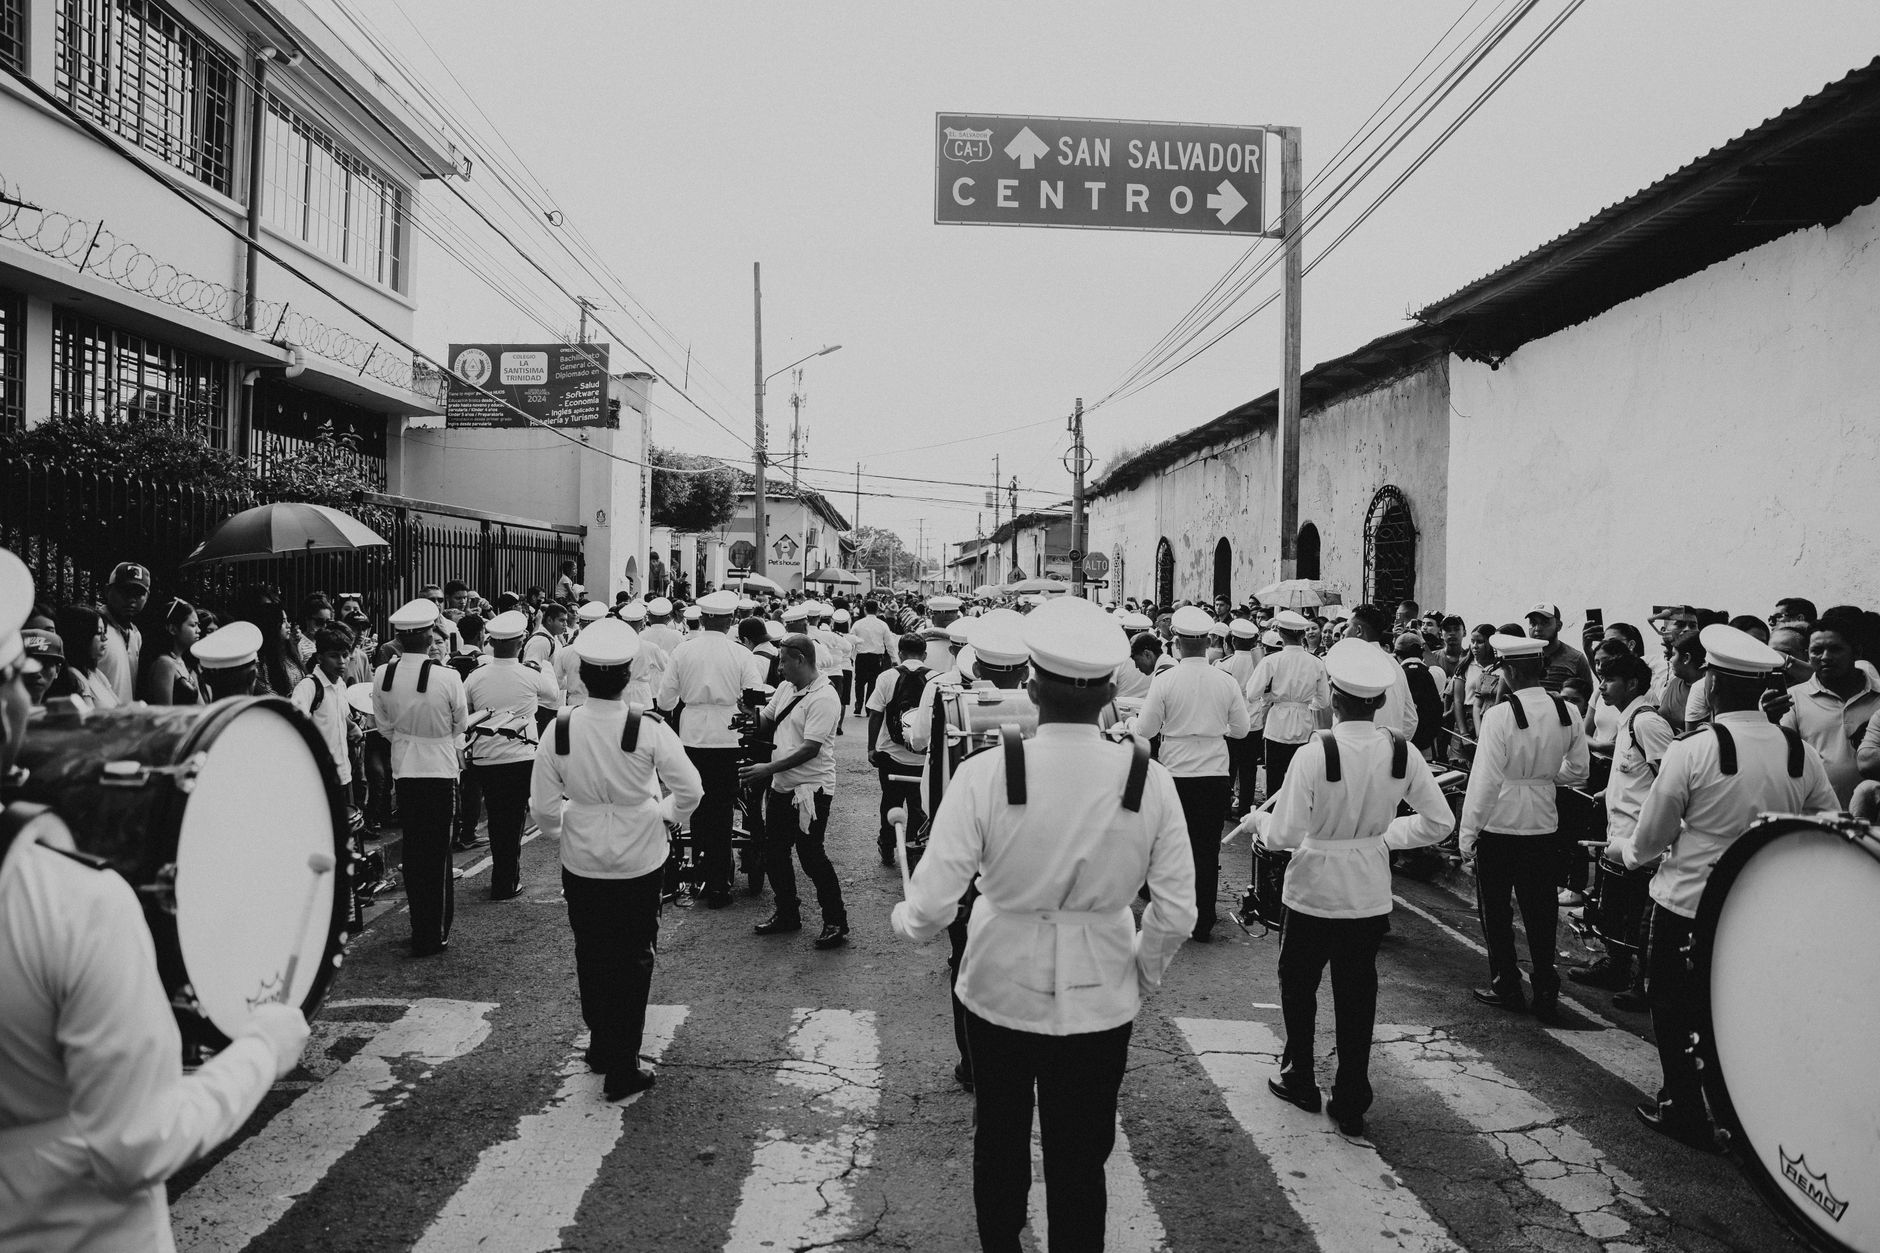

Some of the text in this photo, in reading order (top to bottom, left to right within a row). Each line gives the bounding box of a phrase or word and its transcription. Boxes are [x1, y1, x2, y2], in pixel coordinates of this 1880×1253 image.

[955, 141, 983, 156] CA-1
[1058, 136, 1260, 174] SAN SALVADOR
[952, 177, 1194, 215] CENTRO
[560, 361, 586, 370] General
[555, 370, 590, 380] Diplomado
[580, 380, 600, 389] Salud
[566, 390, 600, 399] Software
[571, 414, 599, 422] Turismo
[1085, 561, 1108, 570] ALTO
[1786, 1164, 1836, 1214] REMO
